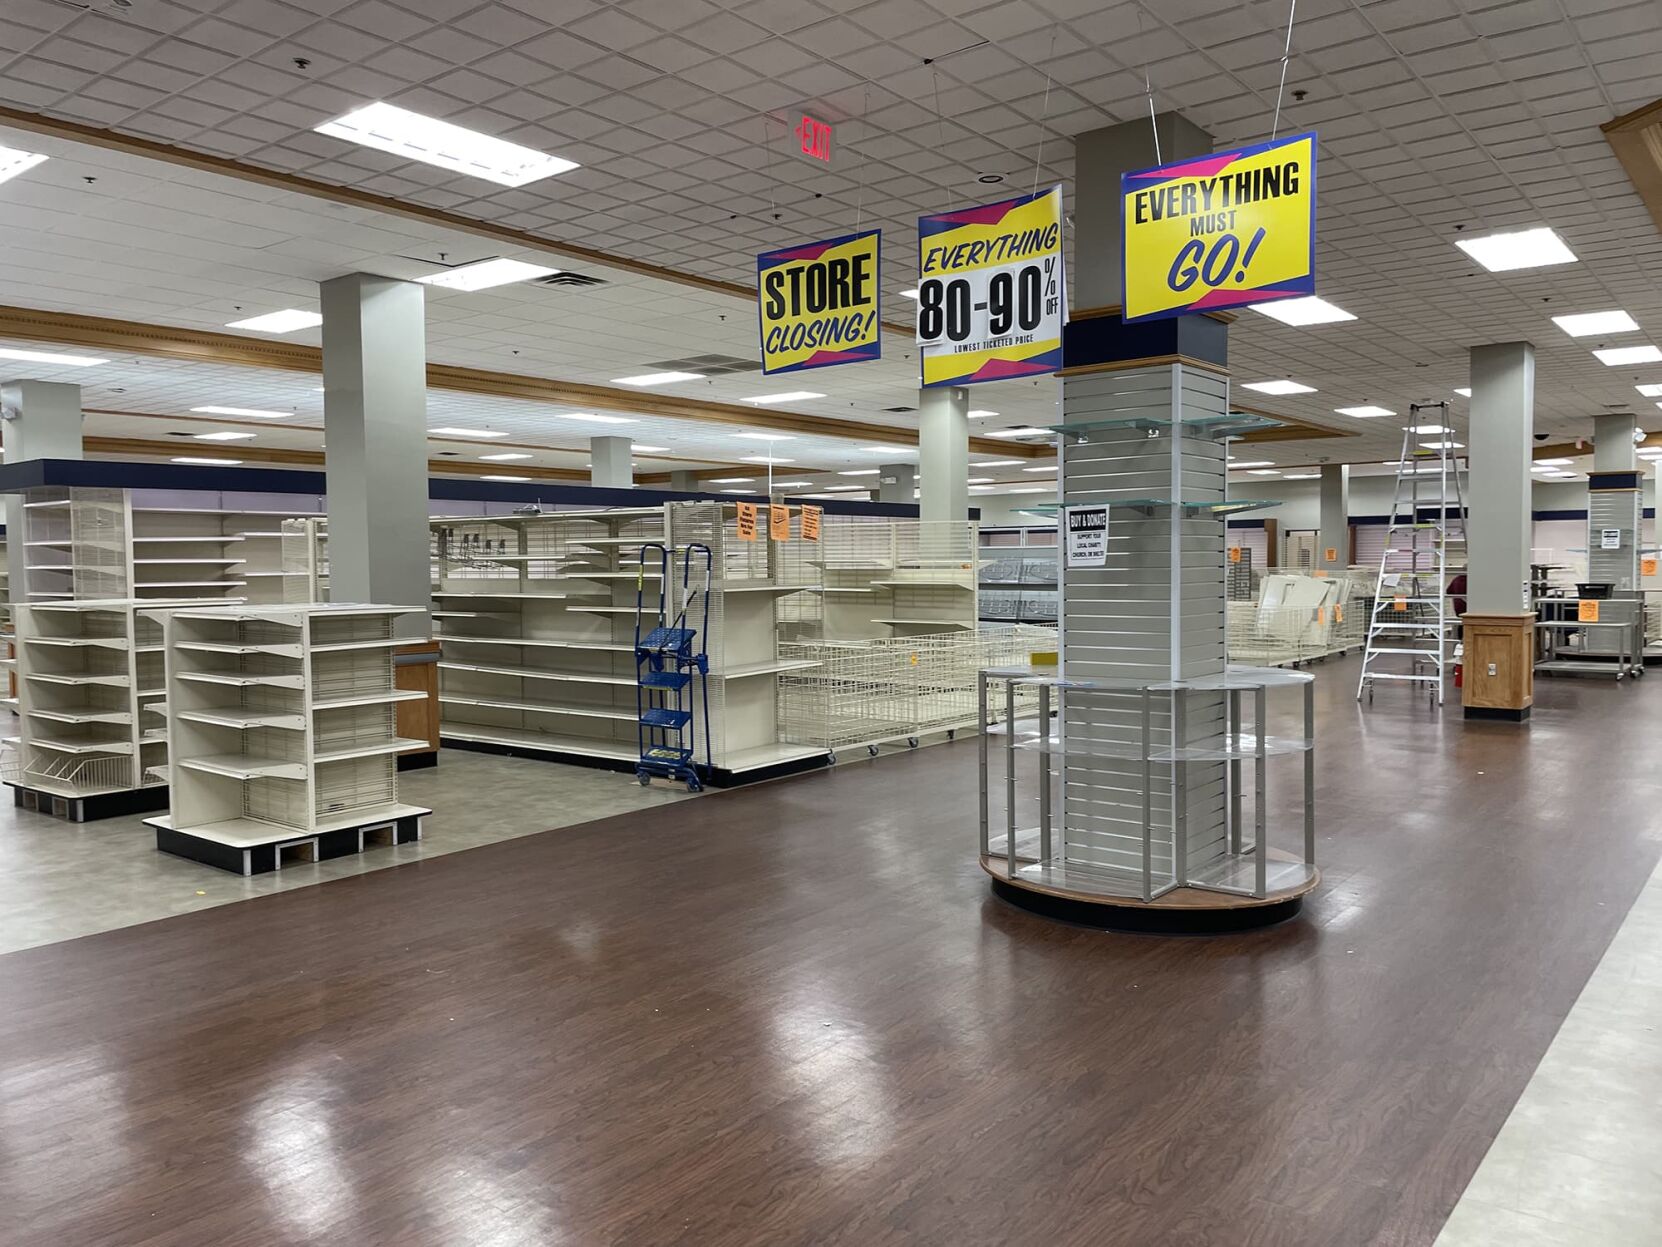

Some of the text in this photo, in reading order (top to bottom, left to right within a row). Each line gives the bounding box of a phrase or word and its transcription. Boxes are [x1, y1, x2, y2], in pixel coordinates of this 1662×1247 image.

[801, 115, 832, 162] EXIT
[1135, 161, 1299, 225] EVERYTHING
[1190, 209, 1237, 237] MUST
[923, 222, 1059, 273] EVERYTHING
[1167, 227, 1266, 292] GO!
[765, 252, 872, 320] STORE
[1046, 296, 1059, 316] OFF
[765, 309, 876, 355] CLOSING!
[954, 333, 1034, 354] LOWEST TICKETED PRICE
[1071, 513, 1106, 527] BUY & DONATE
